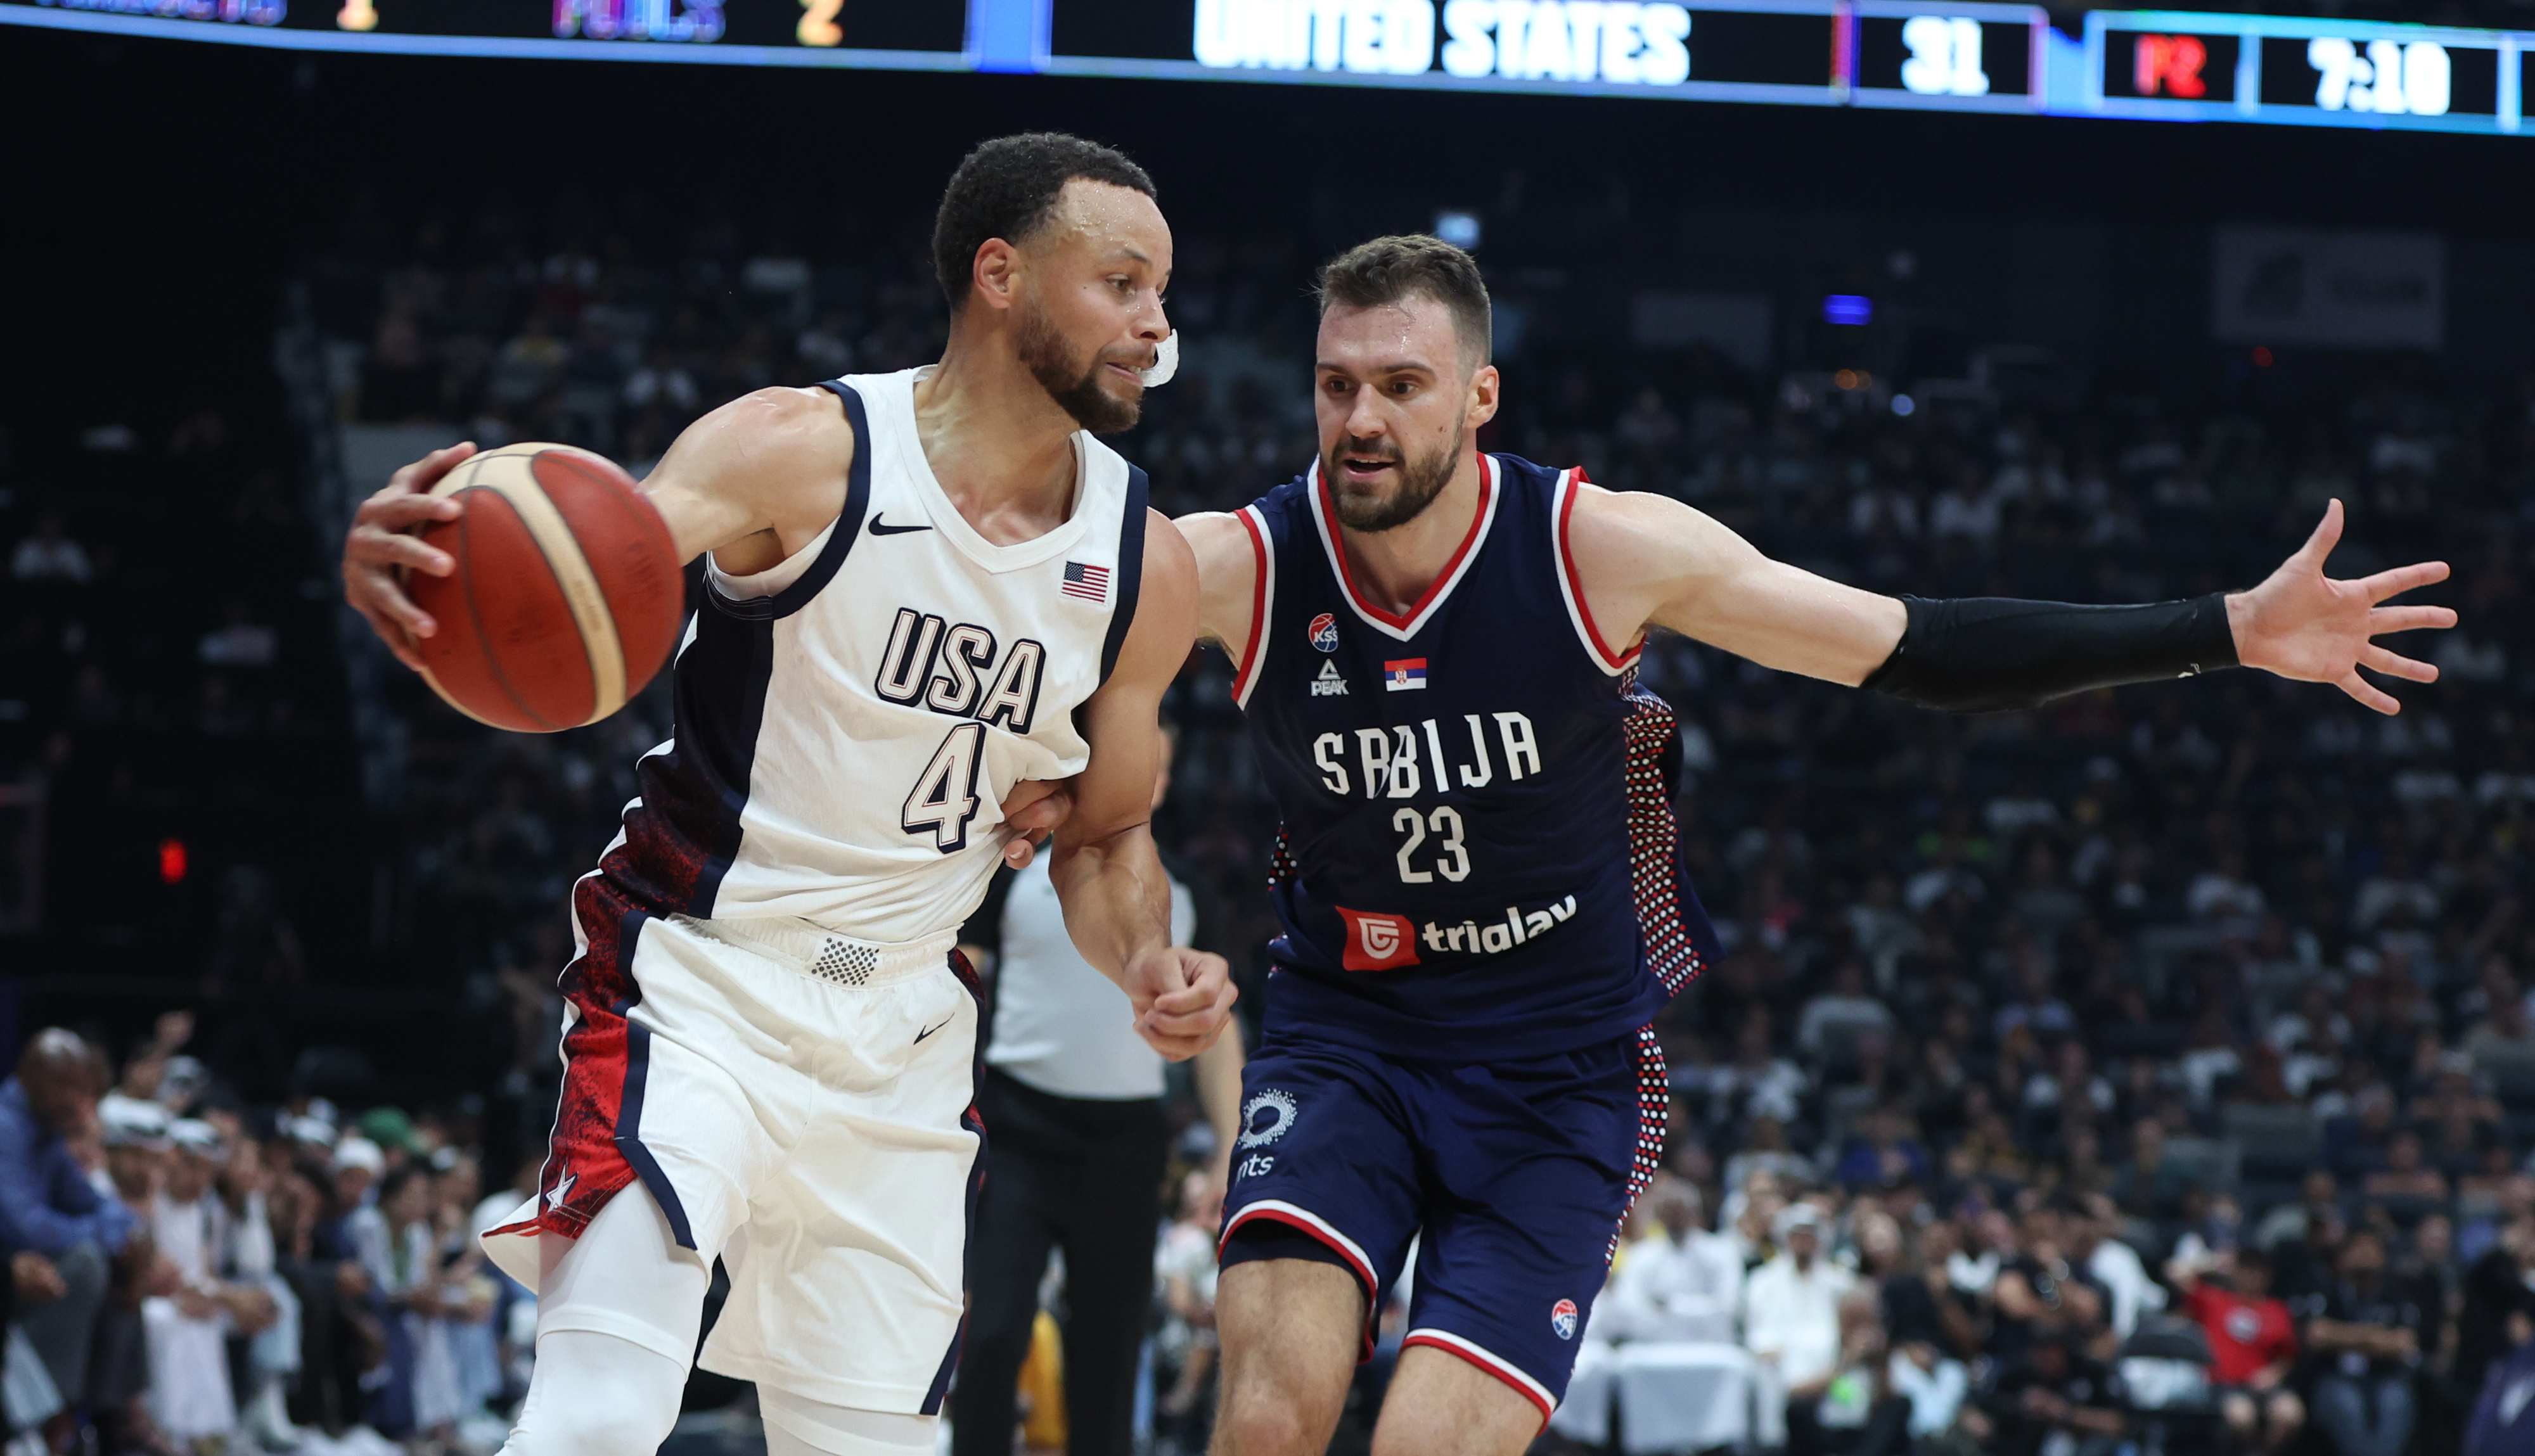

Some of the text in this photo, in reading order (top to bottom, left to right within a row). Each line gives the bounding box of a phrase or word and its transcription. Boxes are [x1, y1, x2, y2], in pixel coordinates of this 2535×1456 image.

[1193, 0, 1691, 86] UNITED STATES
[1902, 16, 1989, 96] 31
[2307, 37, 2451, 115] 7:10
[875, 607, 1046, 734] USA
[1311, 679, 1349, 696] PEAK
[902, 722, 986, 853] 4
[1313, 711, 1541, 800] SRBIJA
[1392, 806, 1471, 883] 23
